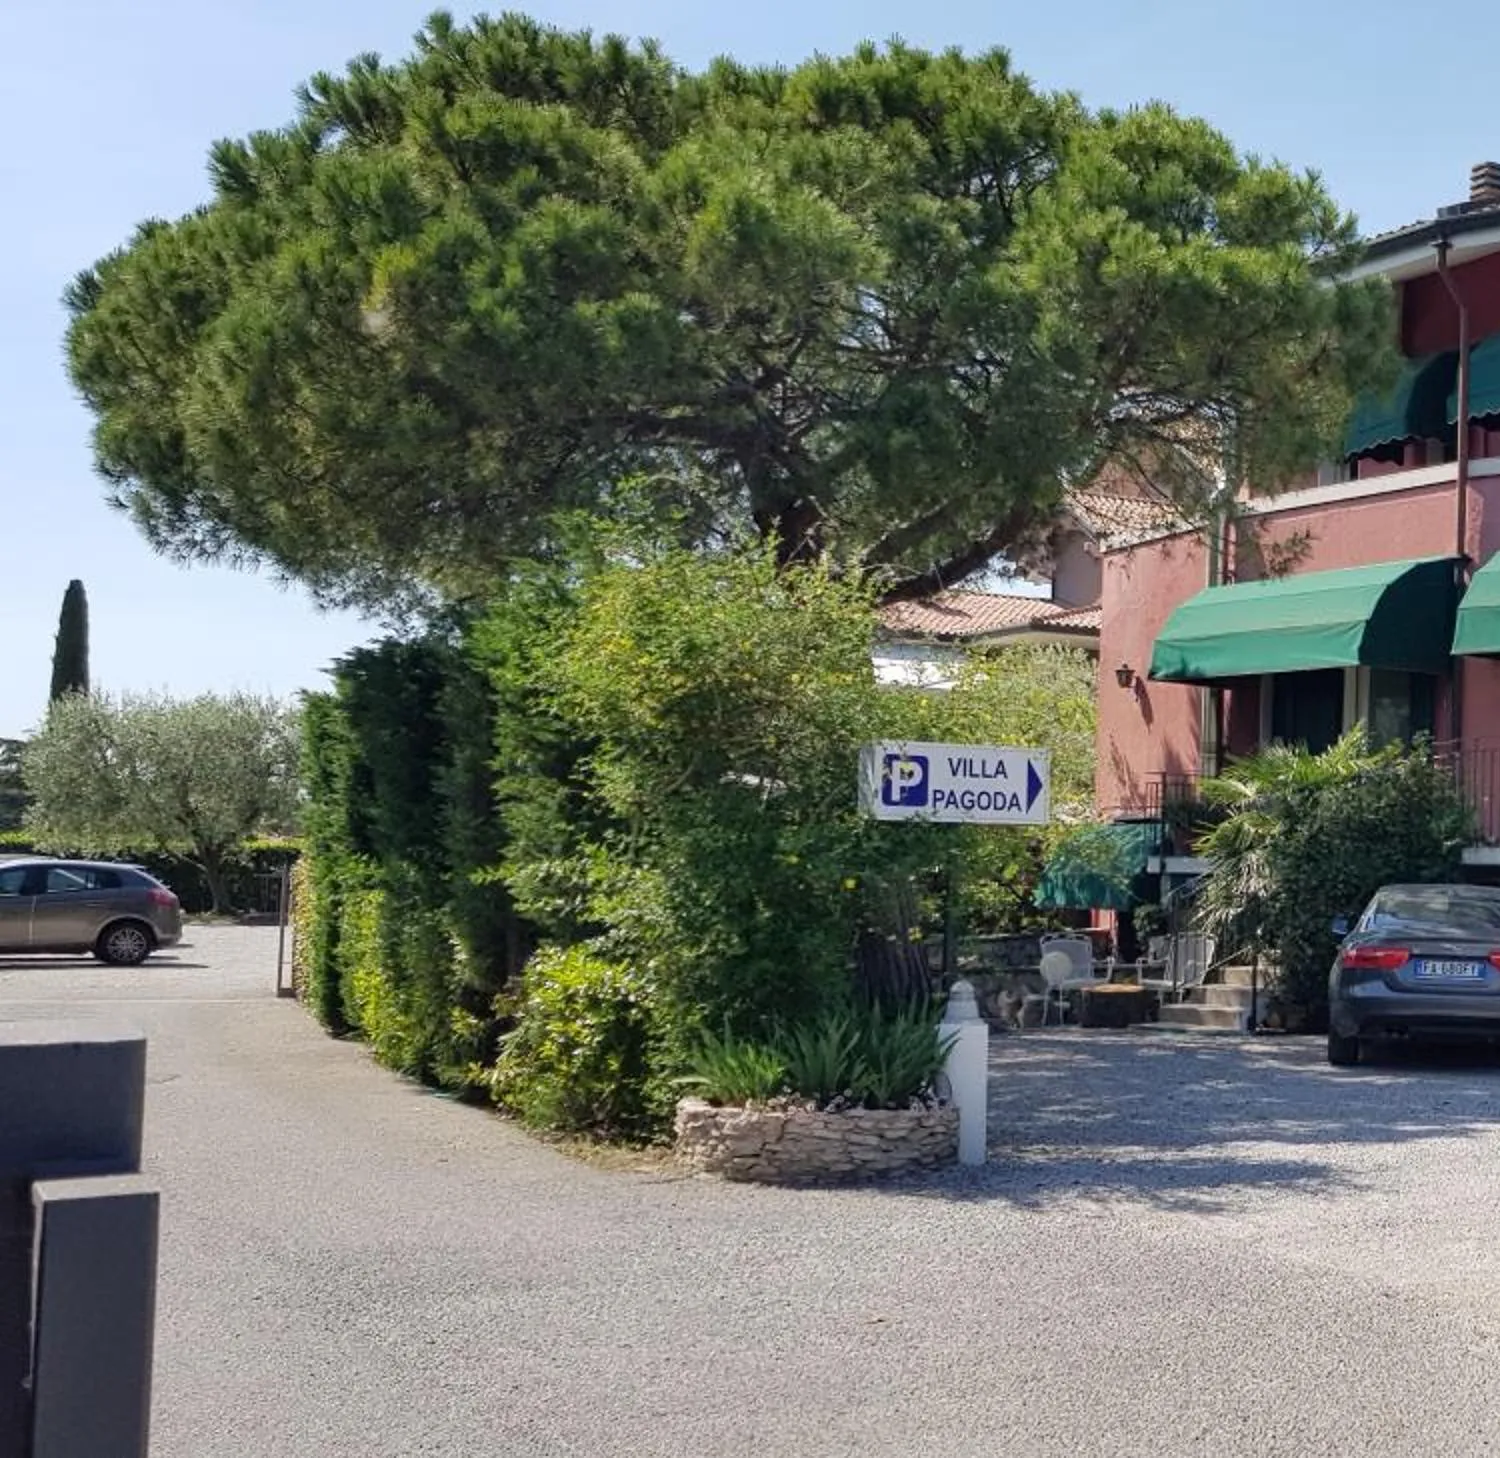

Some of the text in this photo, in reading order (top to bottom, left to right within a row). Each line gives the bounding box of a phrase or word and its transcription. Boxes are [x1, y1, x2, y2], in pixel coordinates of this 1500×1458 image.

[947, 757, 1008, 779] VILLA
[891, 760, 924, 802] P
[932, 788, 1023, 812] PAGODA
